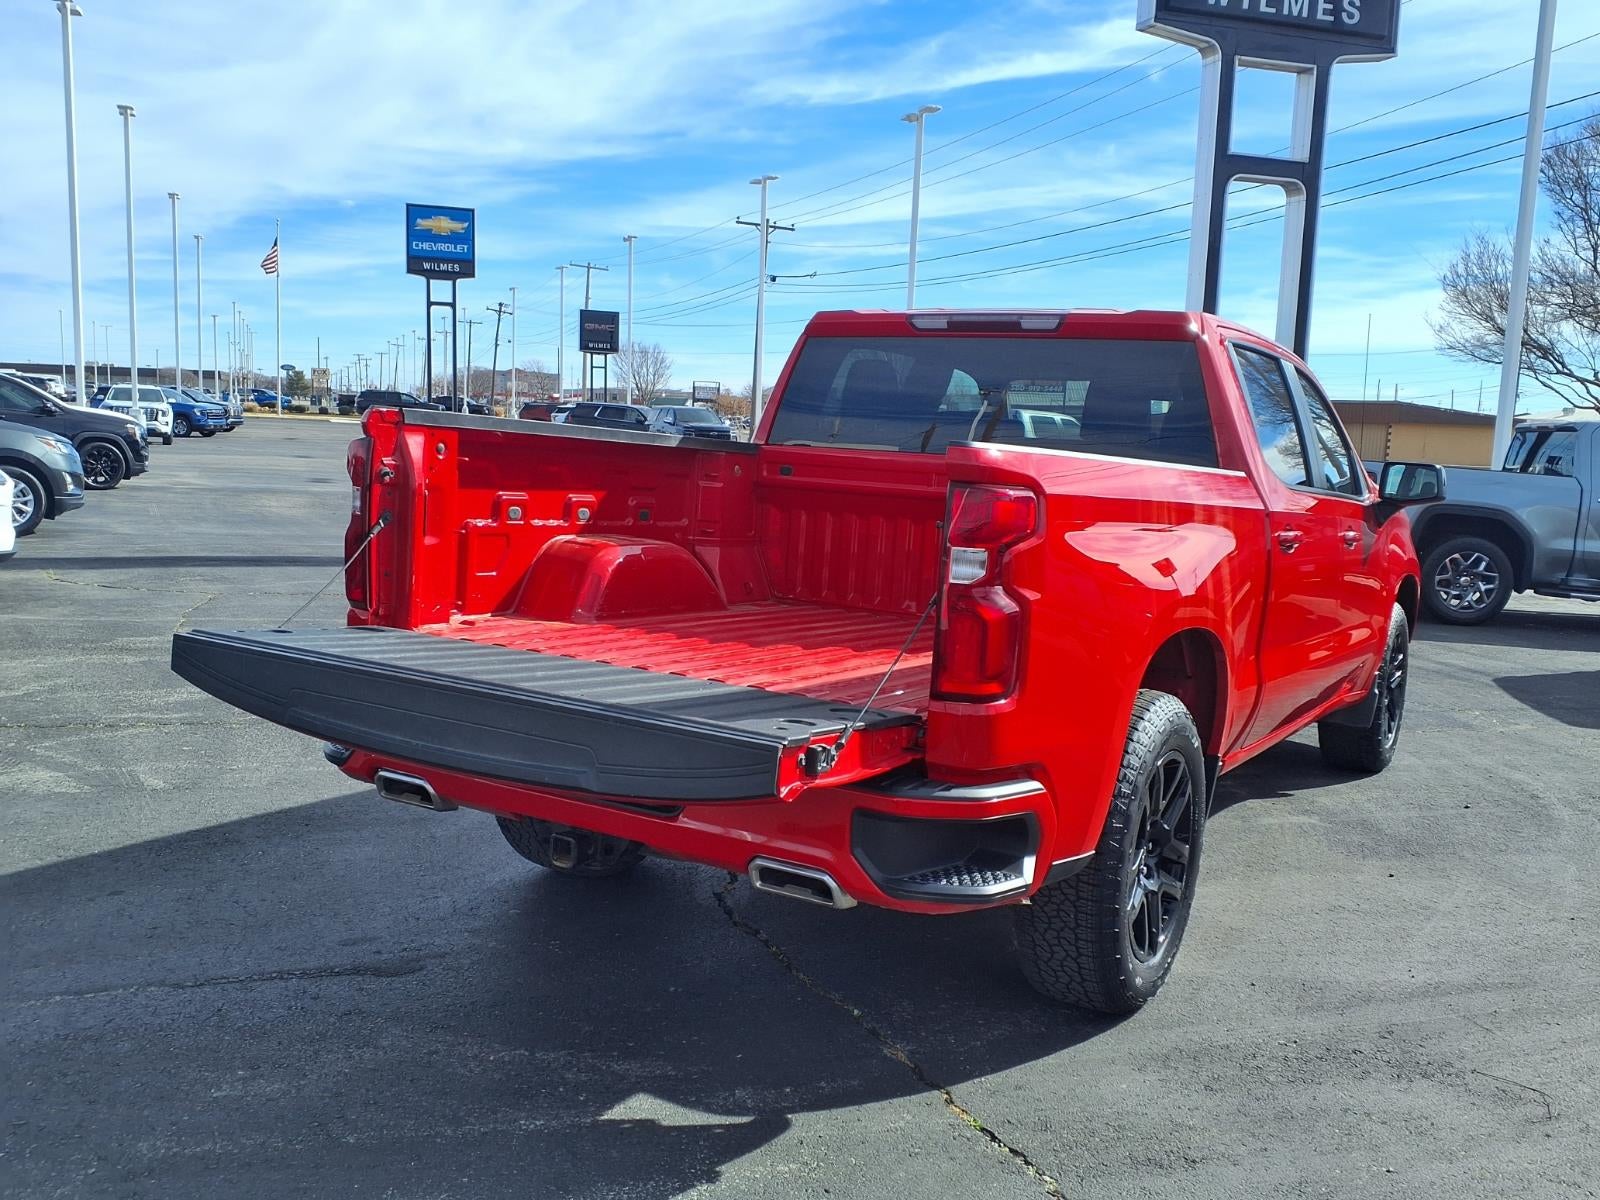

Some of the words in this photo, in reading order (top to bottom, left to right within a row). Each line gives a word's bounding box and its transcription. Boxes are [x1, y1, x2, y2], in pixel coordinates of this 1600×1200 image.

[1207, 0, 1361, 24] MES
[412, 241, 468, 253] CHEVROLET
[423, 262, 460, 272] WILMES
[584, 323, 615, 331] GMC
